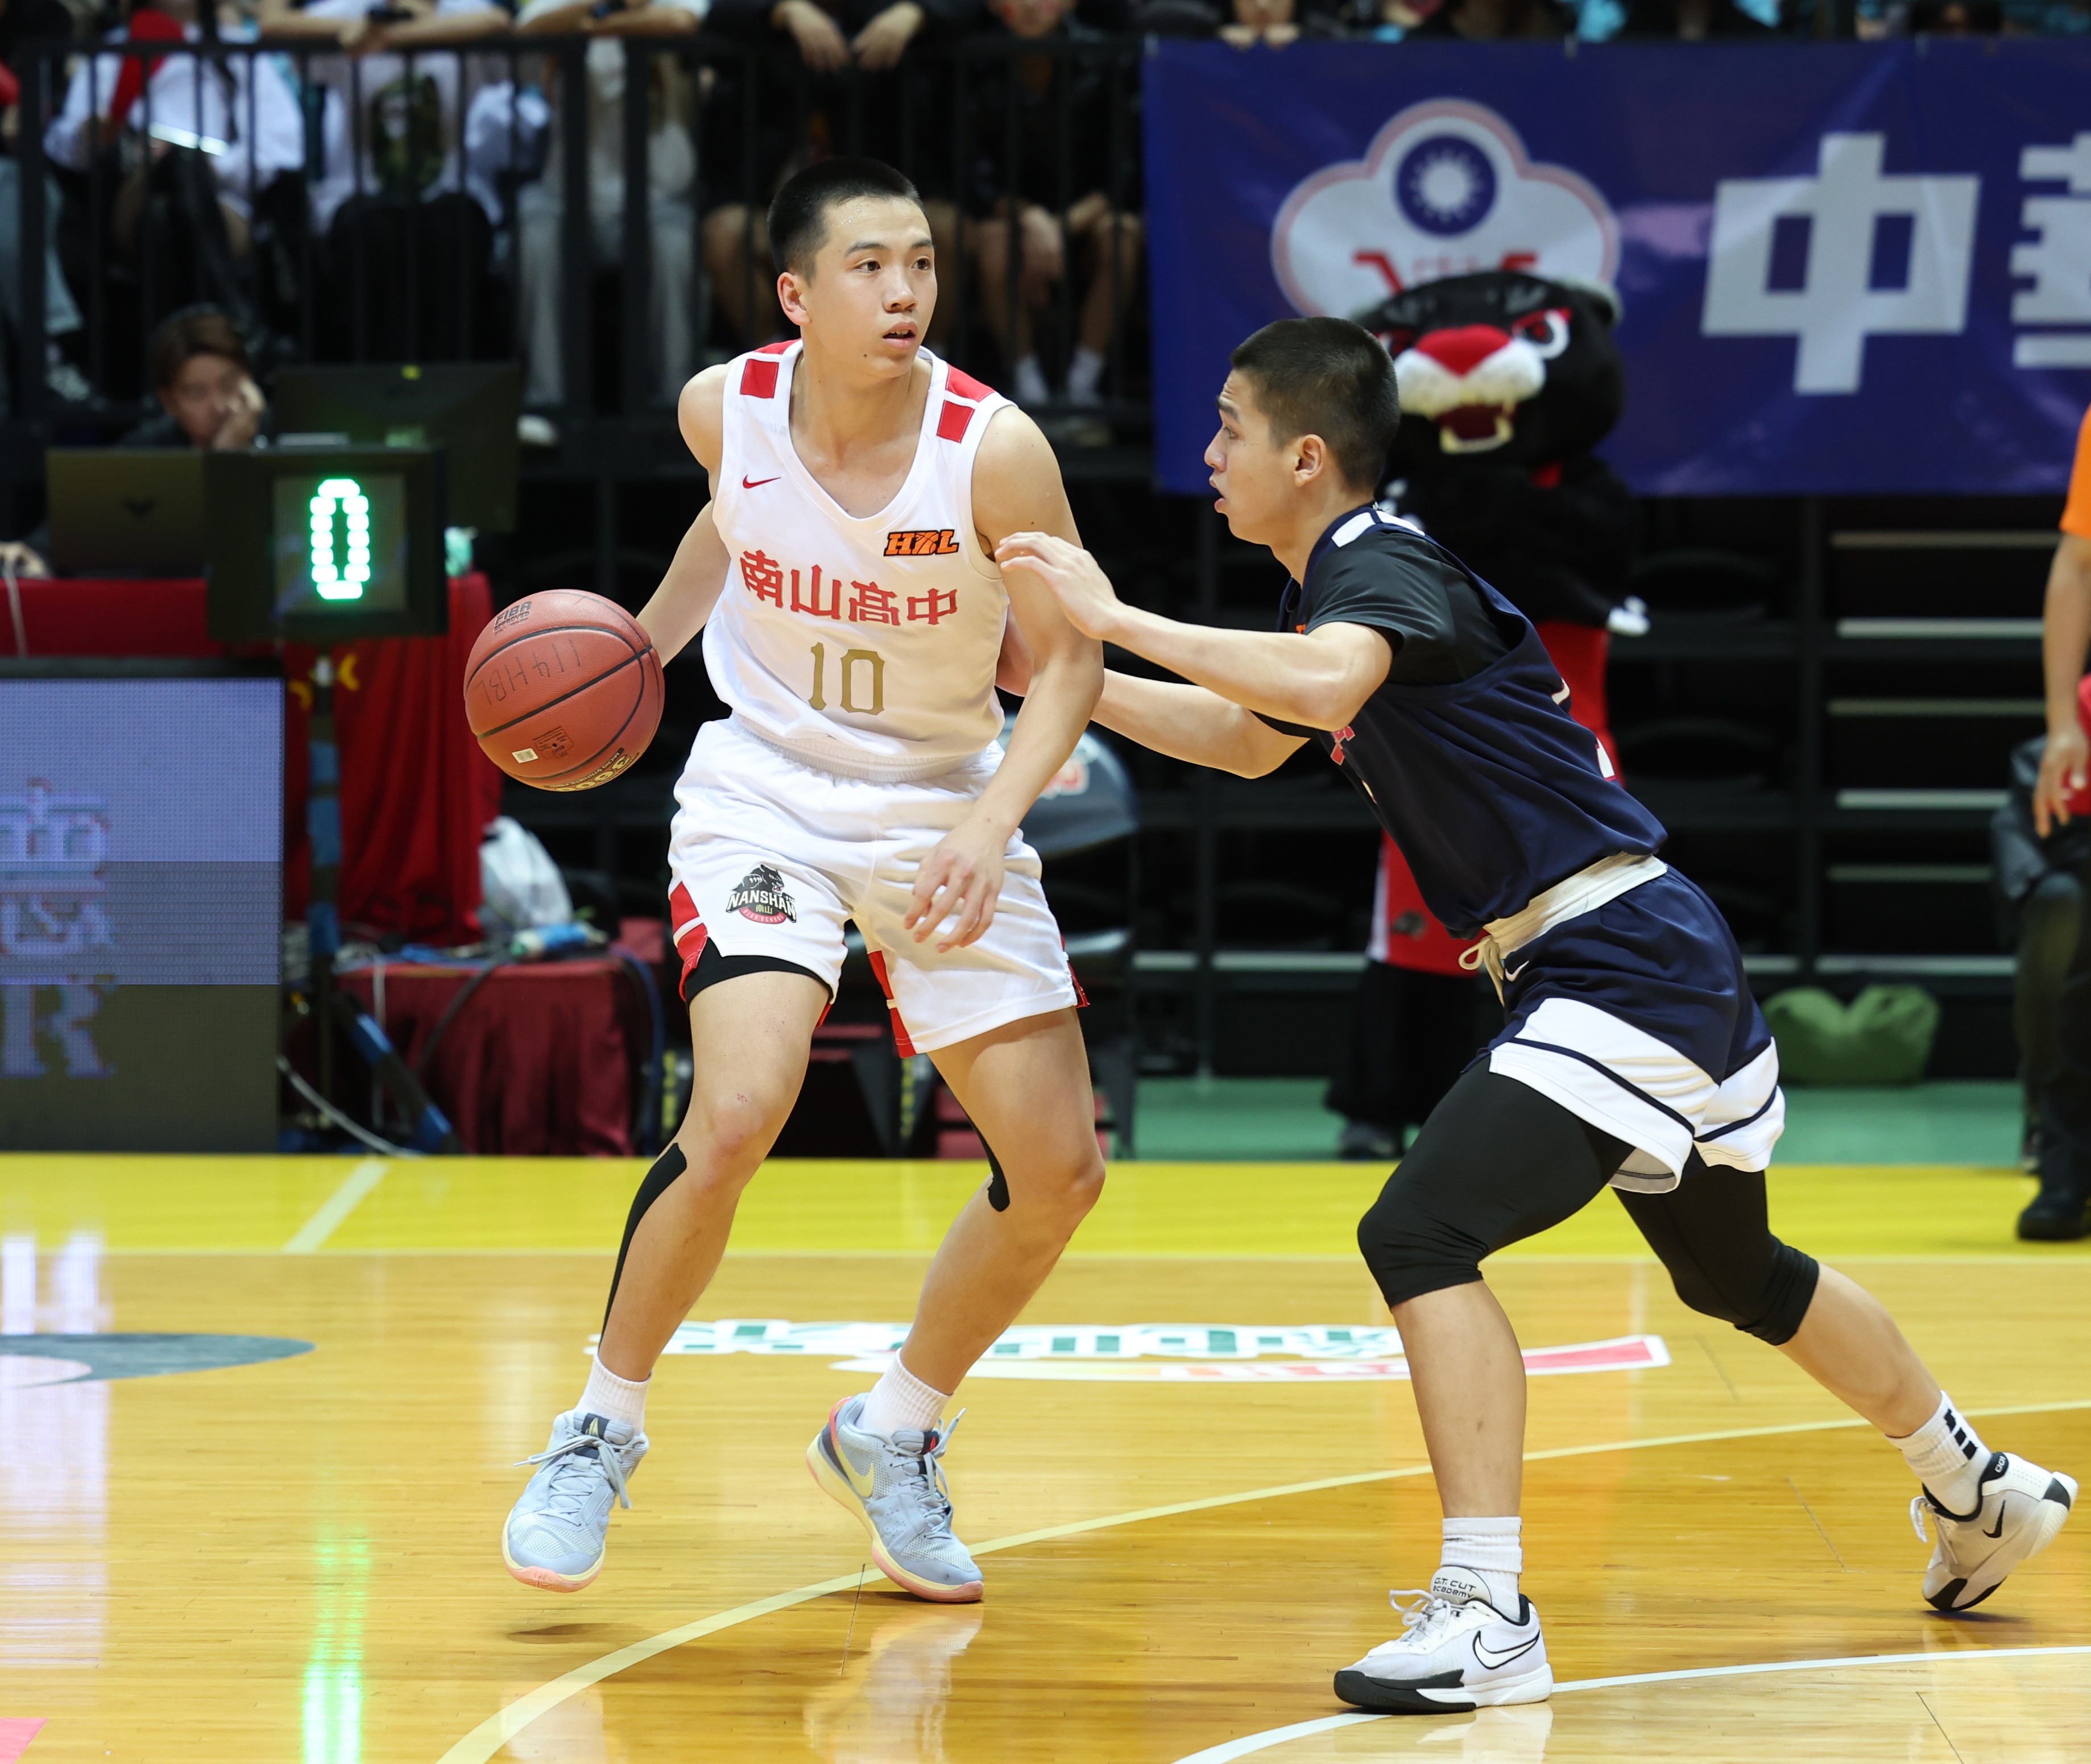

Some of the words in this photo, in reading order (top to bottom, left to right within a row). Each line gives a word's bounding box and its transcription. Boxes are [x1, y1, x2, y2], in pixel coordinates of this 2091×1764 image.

[309, 479, 371, 600] 0
[884, 529, 959, 556] HBL
[740, 549, 958, 626] 南山高中
[494, 611, 530, 632] APPROVED
[495, 601, 532, 626] FIBA
[808, 641, 885, 716] 10
[727, 890, 796, 921] NANSHAN
[743, 909, 758, 920] HIGH
[760, 914, 784, 922] SCHOOL
[755, 904, 773, 914] 南山
[1450, 1580, 1477, 1592] CUT
